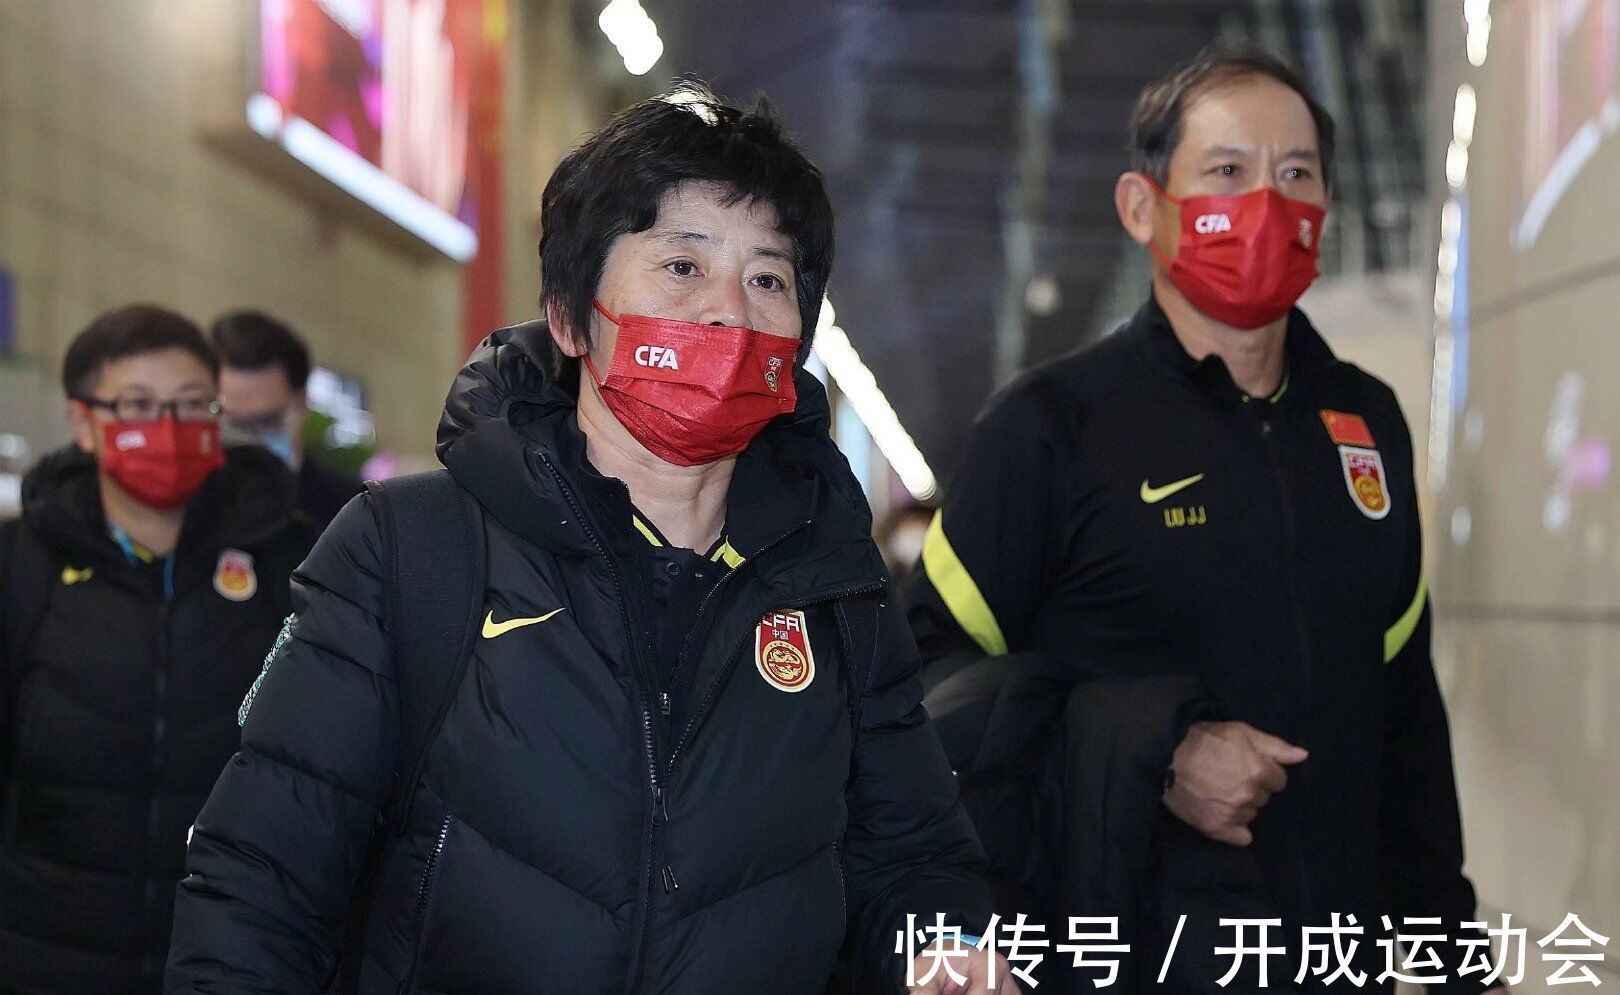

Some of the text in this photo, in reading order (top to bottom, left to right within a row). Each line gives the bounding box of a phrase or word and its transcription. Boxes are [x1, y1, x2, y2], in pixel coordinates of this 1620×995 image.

[1194, 213, 1232, 234] CFA
[634, 345, 679, 370] CFA
[771, 628, 789, 640] 中国
